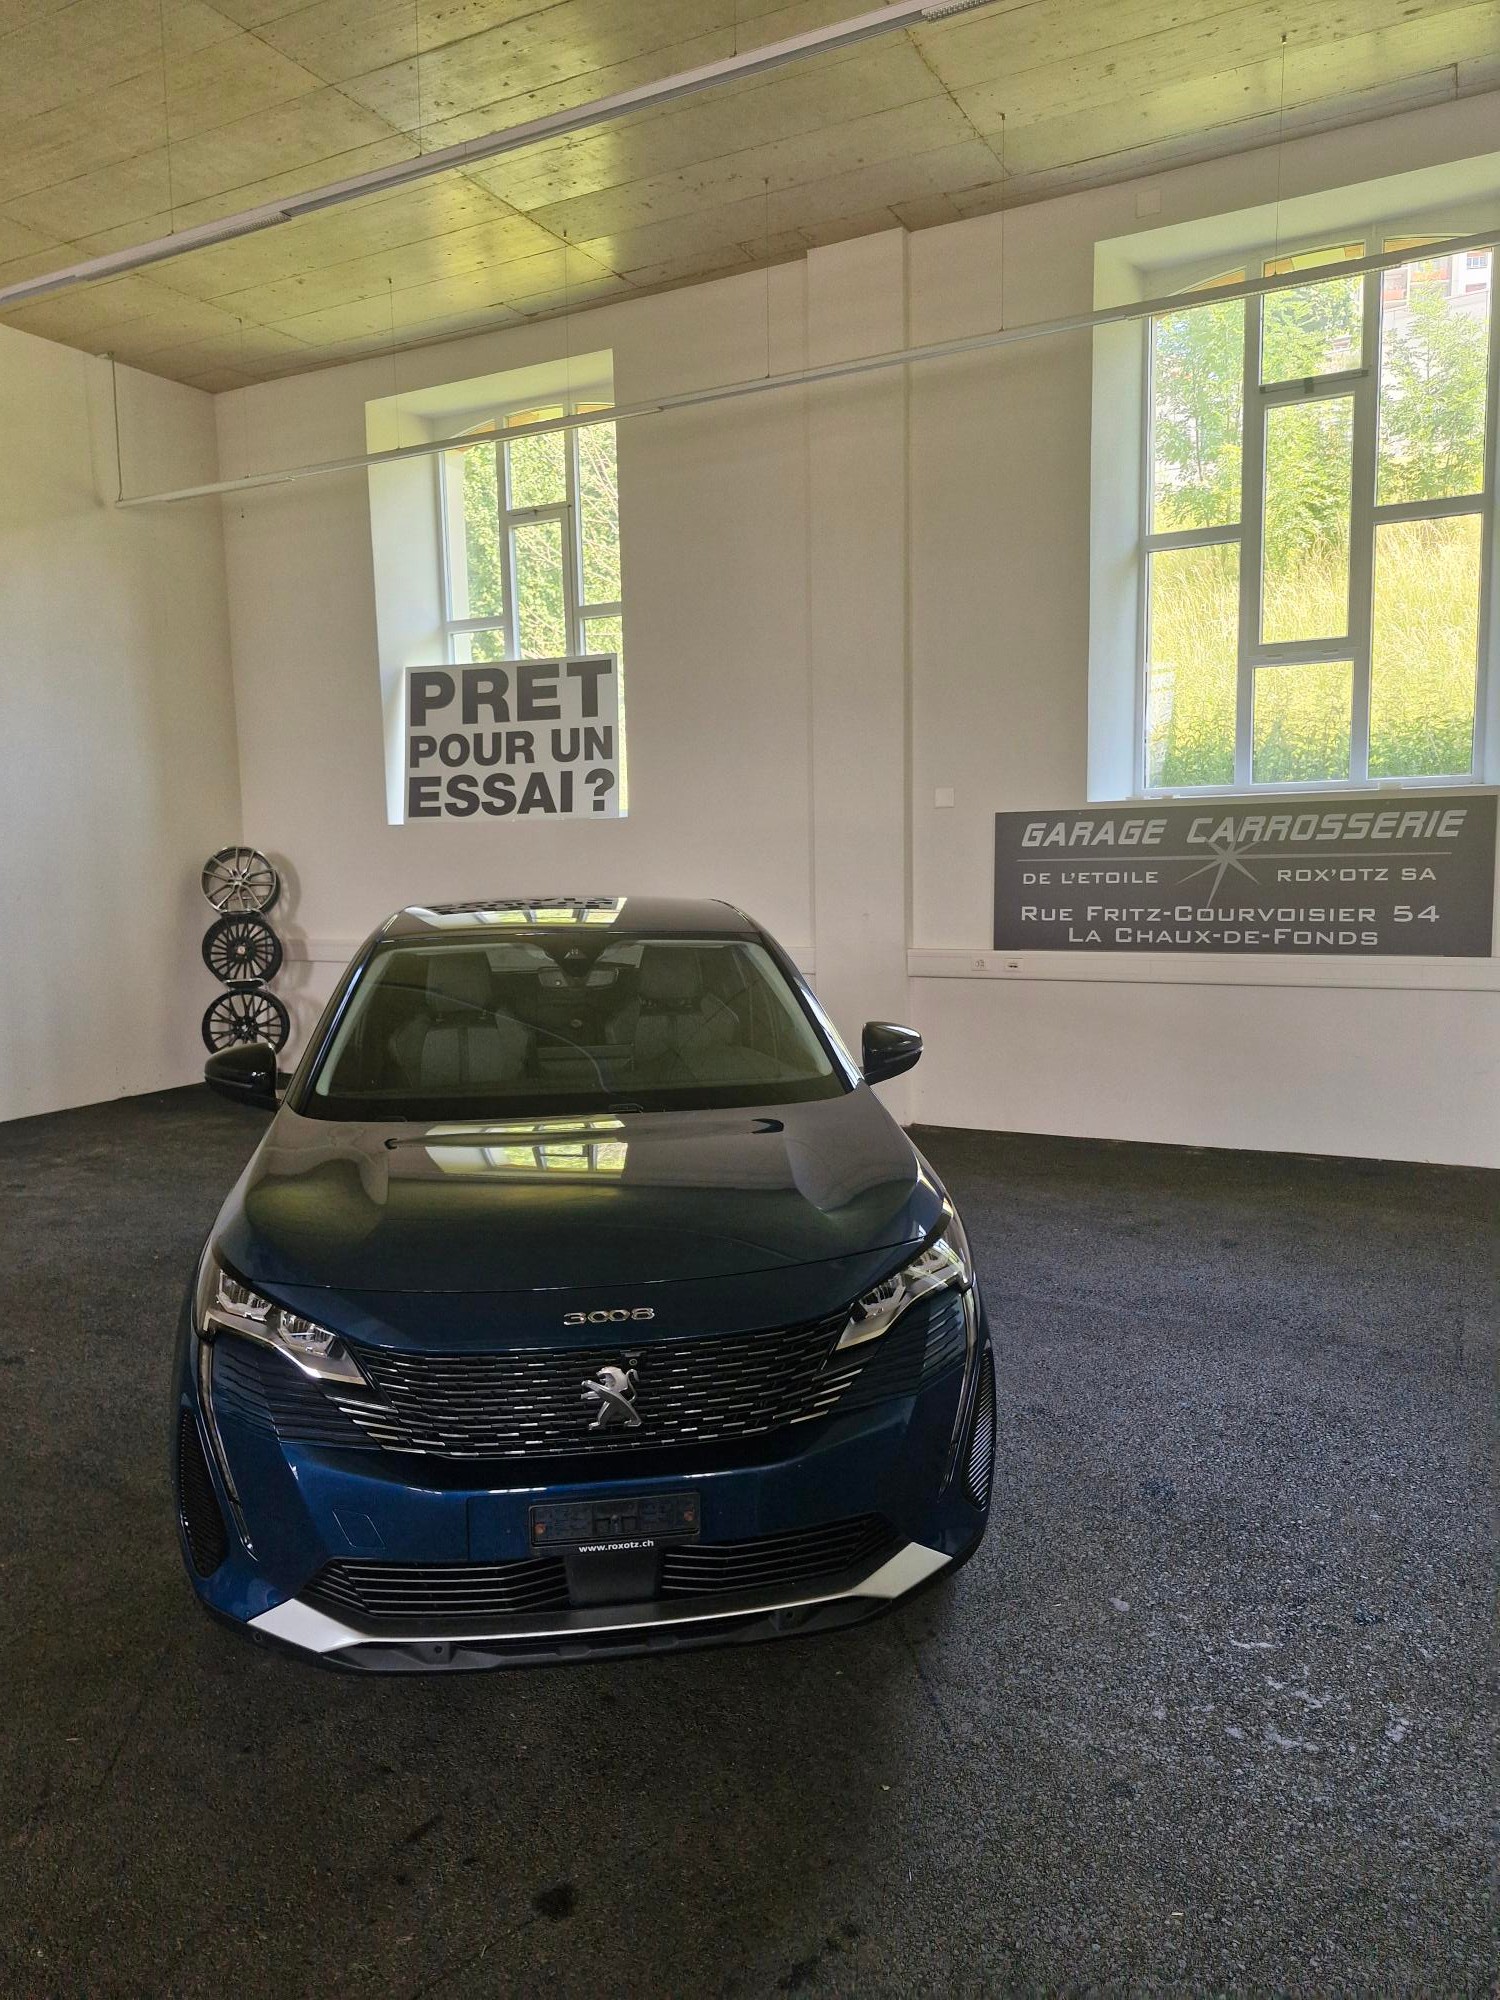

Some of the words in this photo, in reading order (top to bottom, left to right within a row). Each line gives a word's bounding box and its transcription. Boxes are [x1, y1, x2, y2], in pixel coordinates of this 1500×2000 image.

[410, 659, 612, 727] PRET
[409, 730, 535, 768] POUR
[551, 725, 613, 762] UN
[1021, 818, 1167, 847] GARAGE
[1185, 809, 1468, 845] CARROSSERIE
[1022, 872, 1055, 885] DE
[1061, 871, 1159, 885] L'ETOILE
[1277, 868, 1389, 882] ROX'OTZ
[1400, 868, 1437, 881] SA
[1393, 905, 1440, 923] 54
[563, 1307, 655, 1326] 3008
[578, 1539, 654, 1553] www.roxotz.ch
